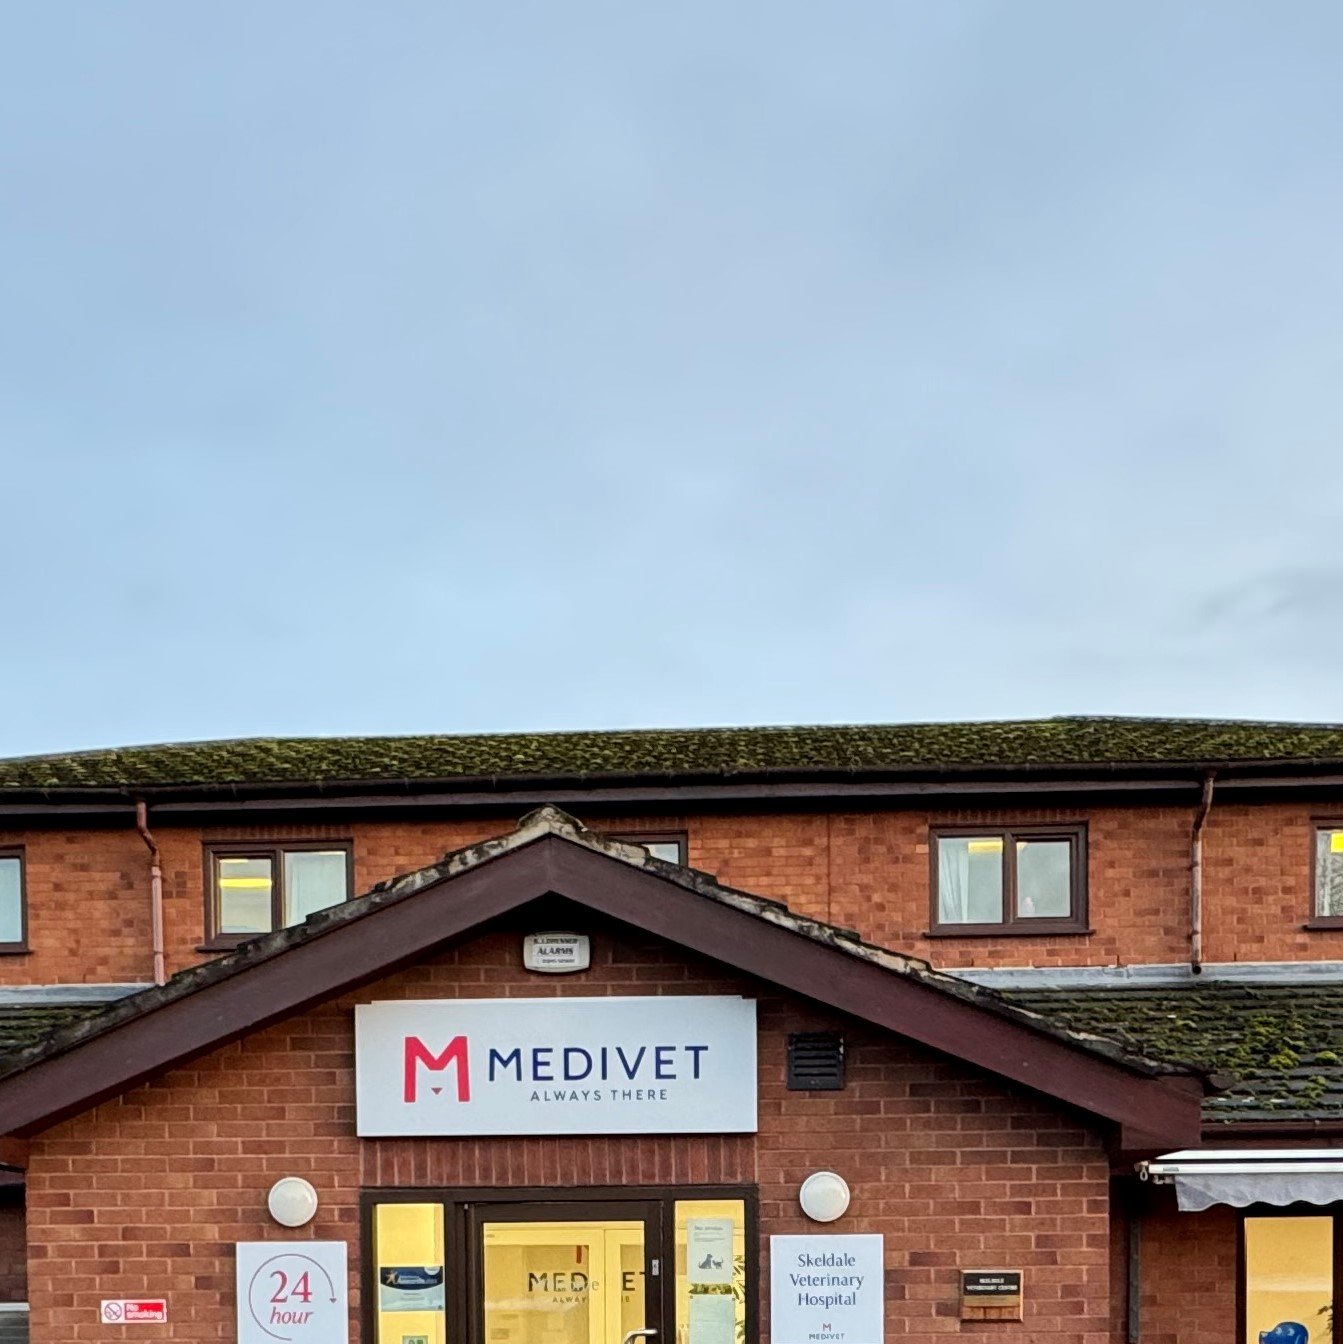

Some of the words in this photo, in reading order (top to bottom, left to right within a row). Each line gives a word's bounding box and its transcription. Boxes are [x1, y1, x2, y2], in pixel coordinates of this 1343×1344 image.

[488, 1045, 709, 1082] MEDIVET
[530, 1089, 602, 1102] ALWAYS
[610, 1088, 668, 1101] THERE
[797, 1252, 856, 1267] Skeldale
[269, 1270, 313, 1303] 24
[789, 1272, 864, 1290] Veterinary
[126, 1303, 140, 1311] No
[797, 1291, 856, 1309] Hospital
[269, 1306, 314, 1324] hour
[808, 1332, 845, 1340] MEDIVET
